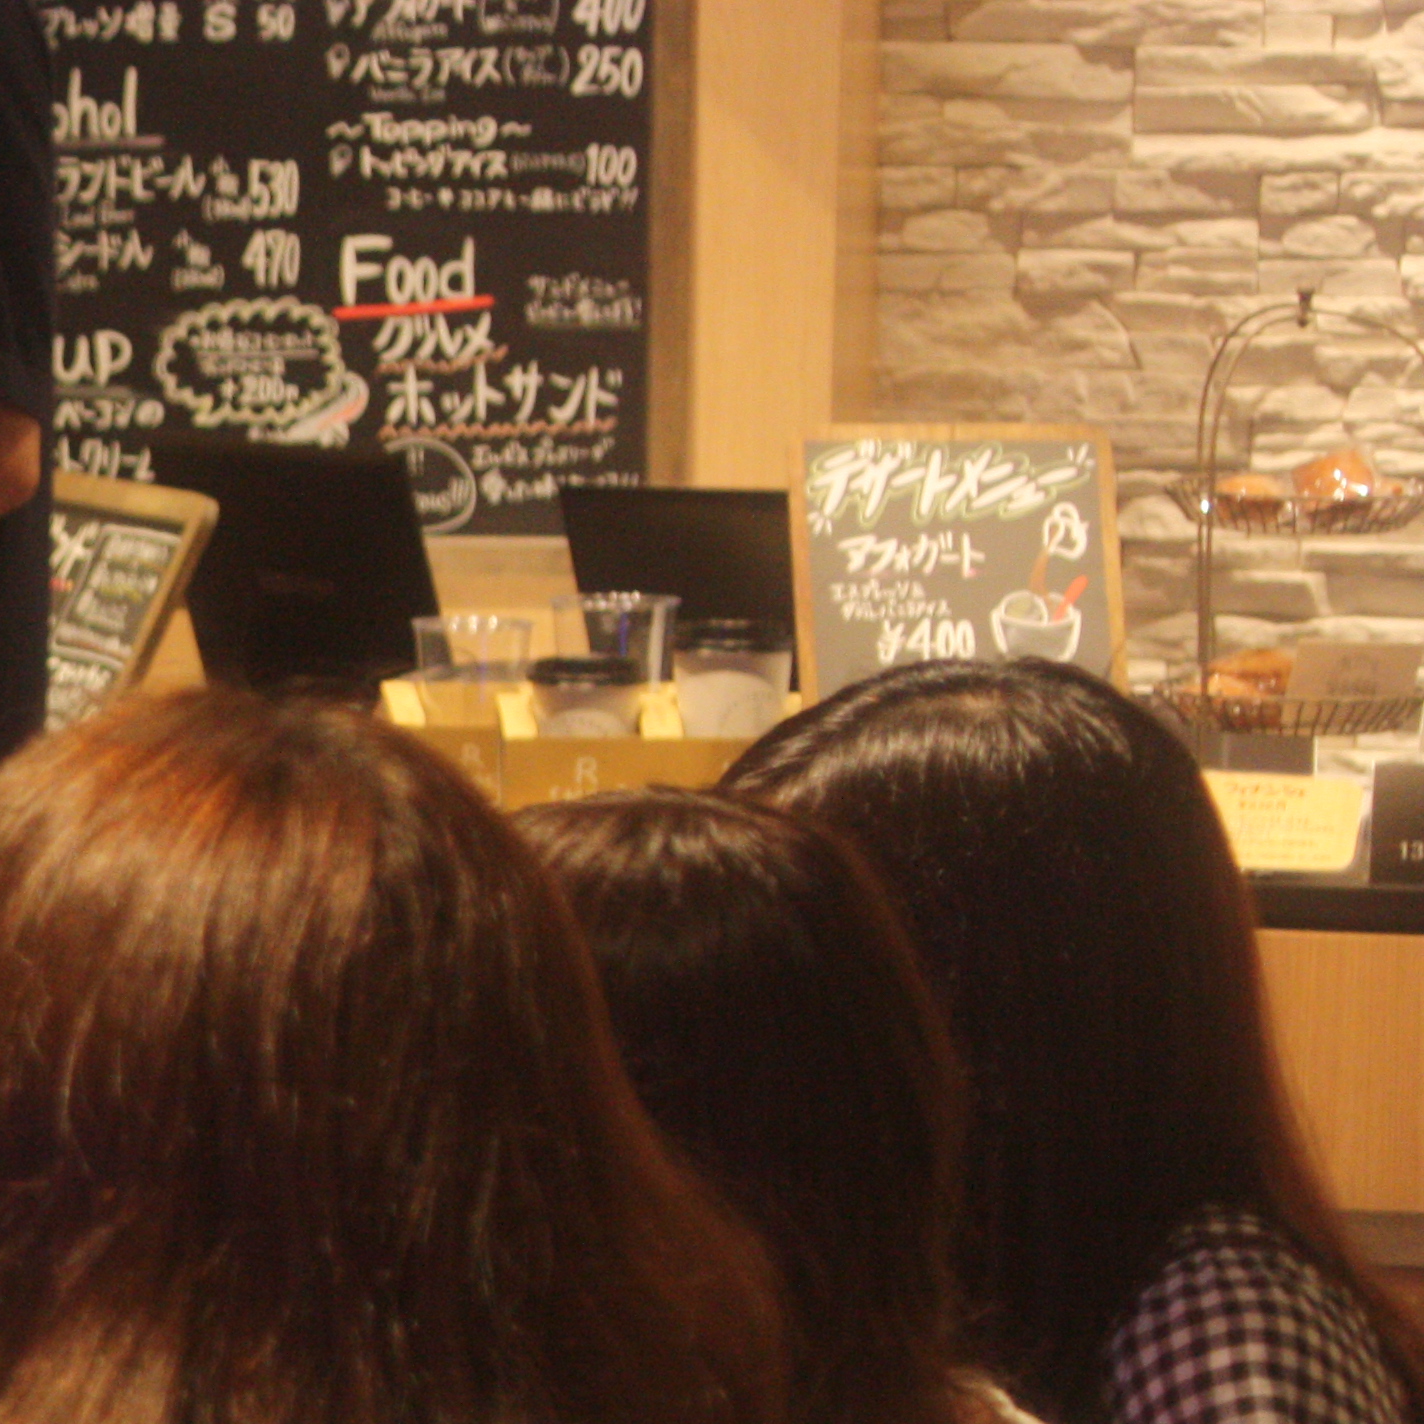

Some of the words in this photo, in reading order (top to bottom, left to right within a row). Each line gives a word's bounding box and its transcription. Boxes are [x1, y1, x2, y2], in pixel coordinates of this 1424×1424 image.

[570, 43, 644, 98] 250
[586, 142, 638, 187] 100
[339, 233, 476, 307] Food
[385, 358, 622, 428] ホットサンド
[807, 438, 1084, 521] デザートメニュー
[876, 616, 977, 665] ¥400
